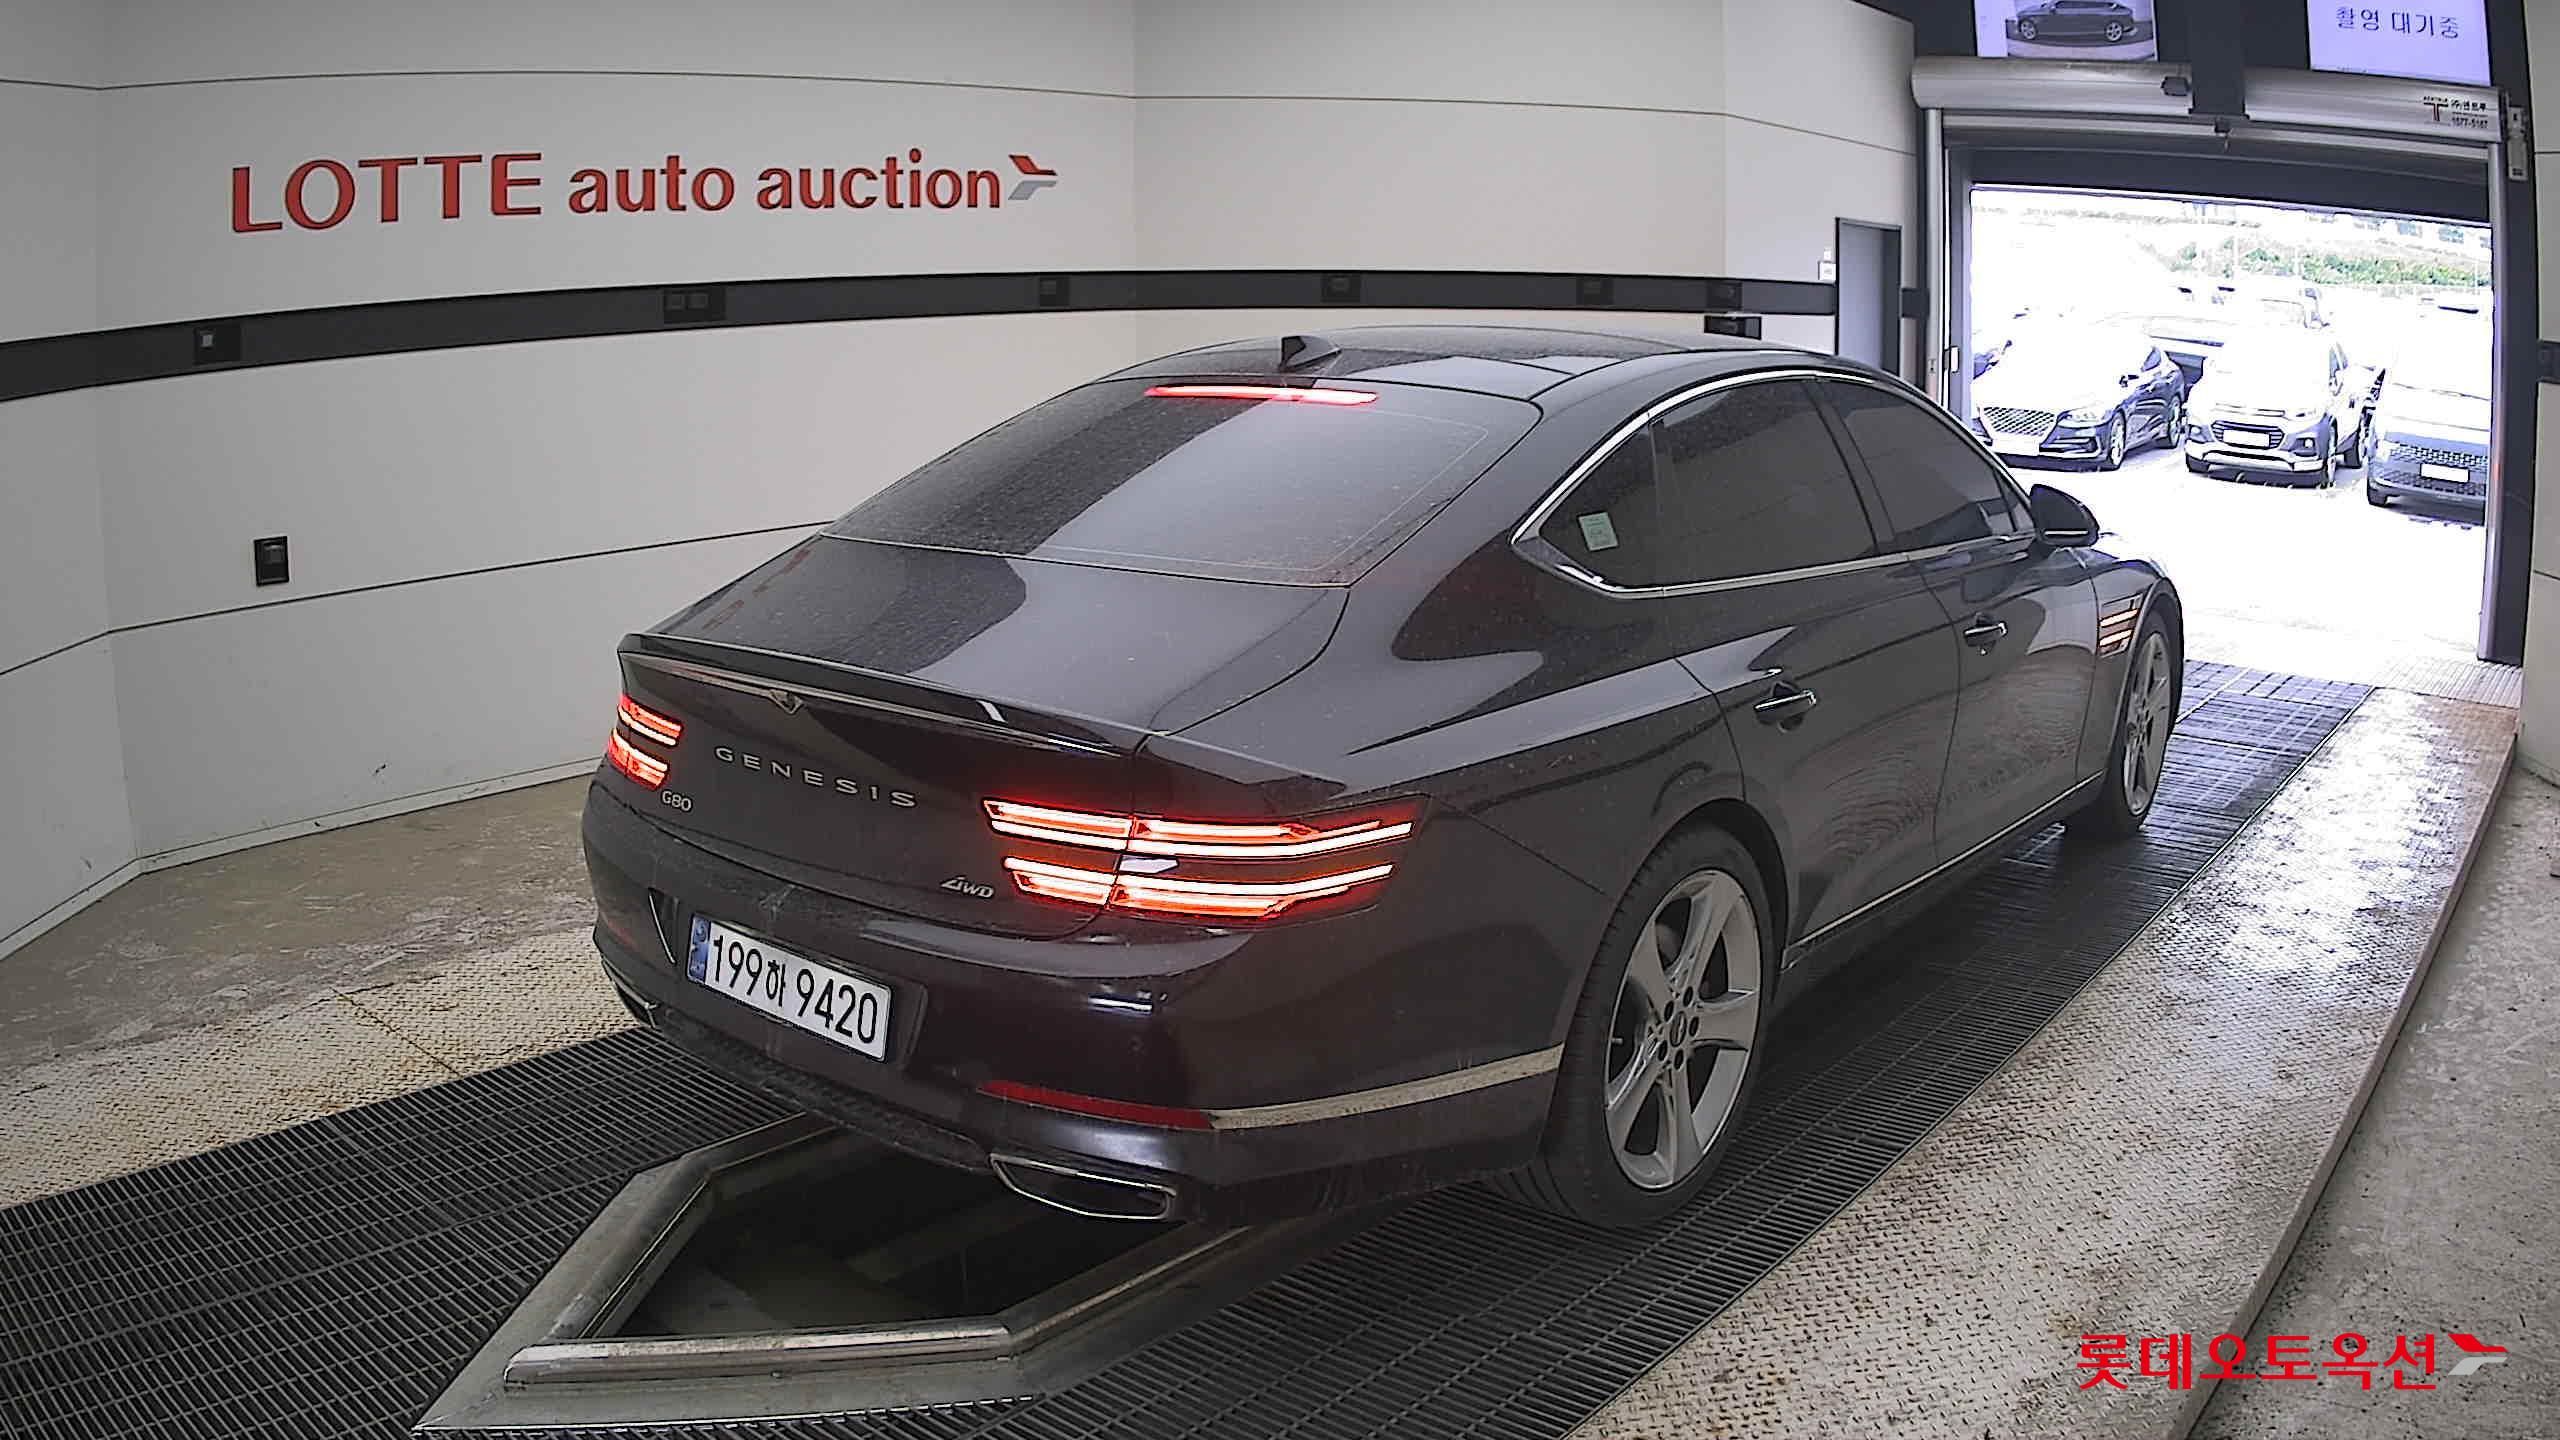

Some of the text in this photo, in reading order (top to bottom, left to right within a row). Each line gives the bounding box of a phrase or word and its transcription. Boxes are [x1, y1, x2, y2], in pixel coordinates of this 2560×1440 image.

[2337, 7, 2459, 40] 촬영 대기중
[232, 150, 1001, 232] LOTTE auto auction
[662, 790, 693, 812] G80
[715, 747, 917, 808] GENESIS
[713, 935, 878, 1044] 199하 9420
